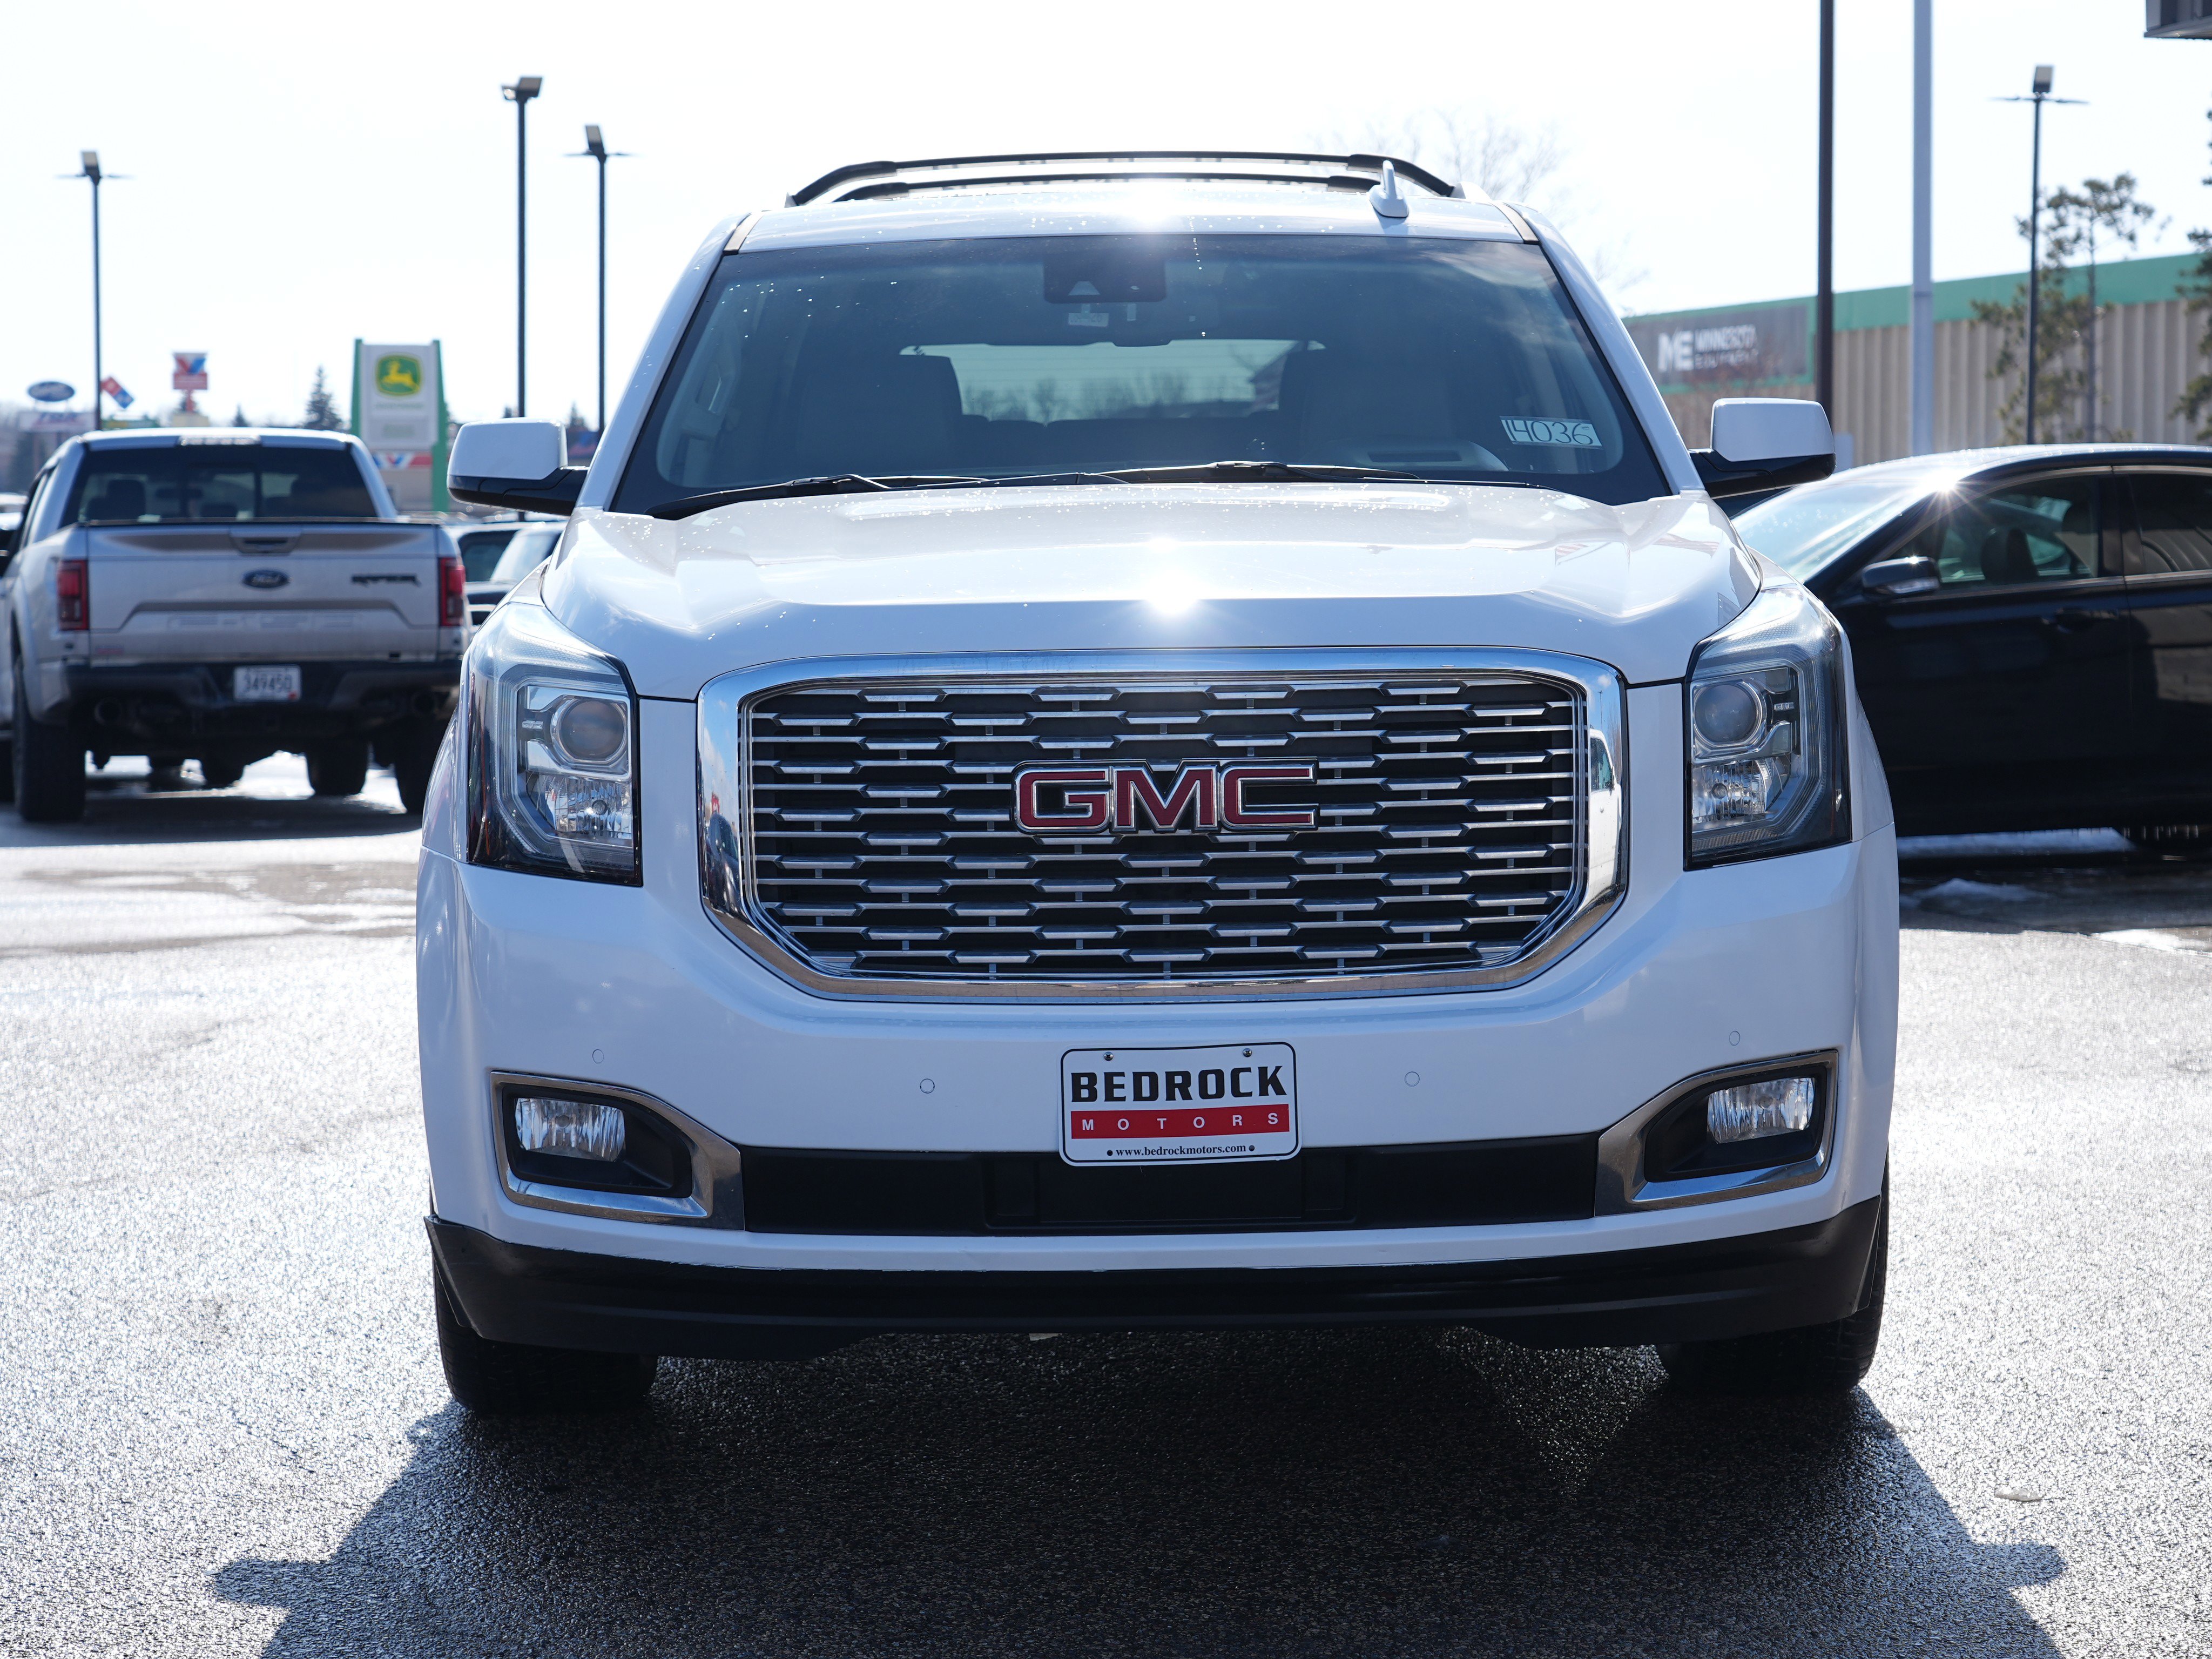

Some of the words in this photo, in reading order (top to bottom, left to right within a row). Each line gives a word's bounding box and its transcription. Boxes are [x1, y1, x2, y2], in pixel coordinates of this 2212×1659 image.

[1505, 419, 1593, 445] 14036
[1014, 759, 1318, 833] GMC
[1070, 1065, 1287, 1103] BEDROCK
[1082, 1112, 1278, 1131] MOTORS
[1116, 1144, 1246, 1157] www.bedrockmotors.com
